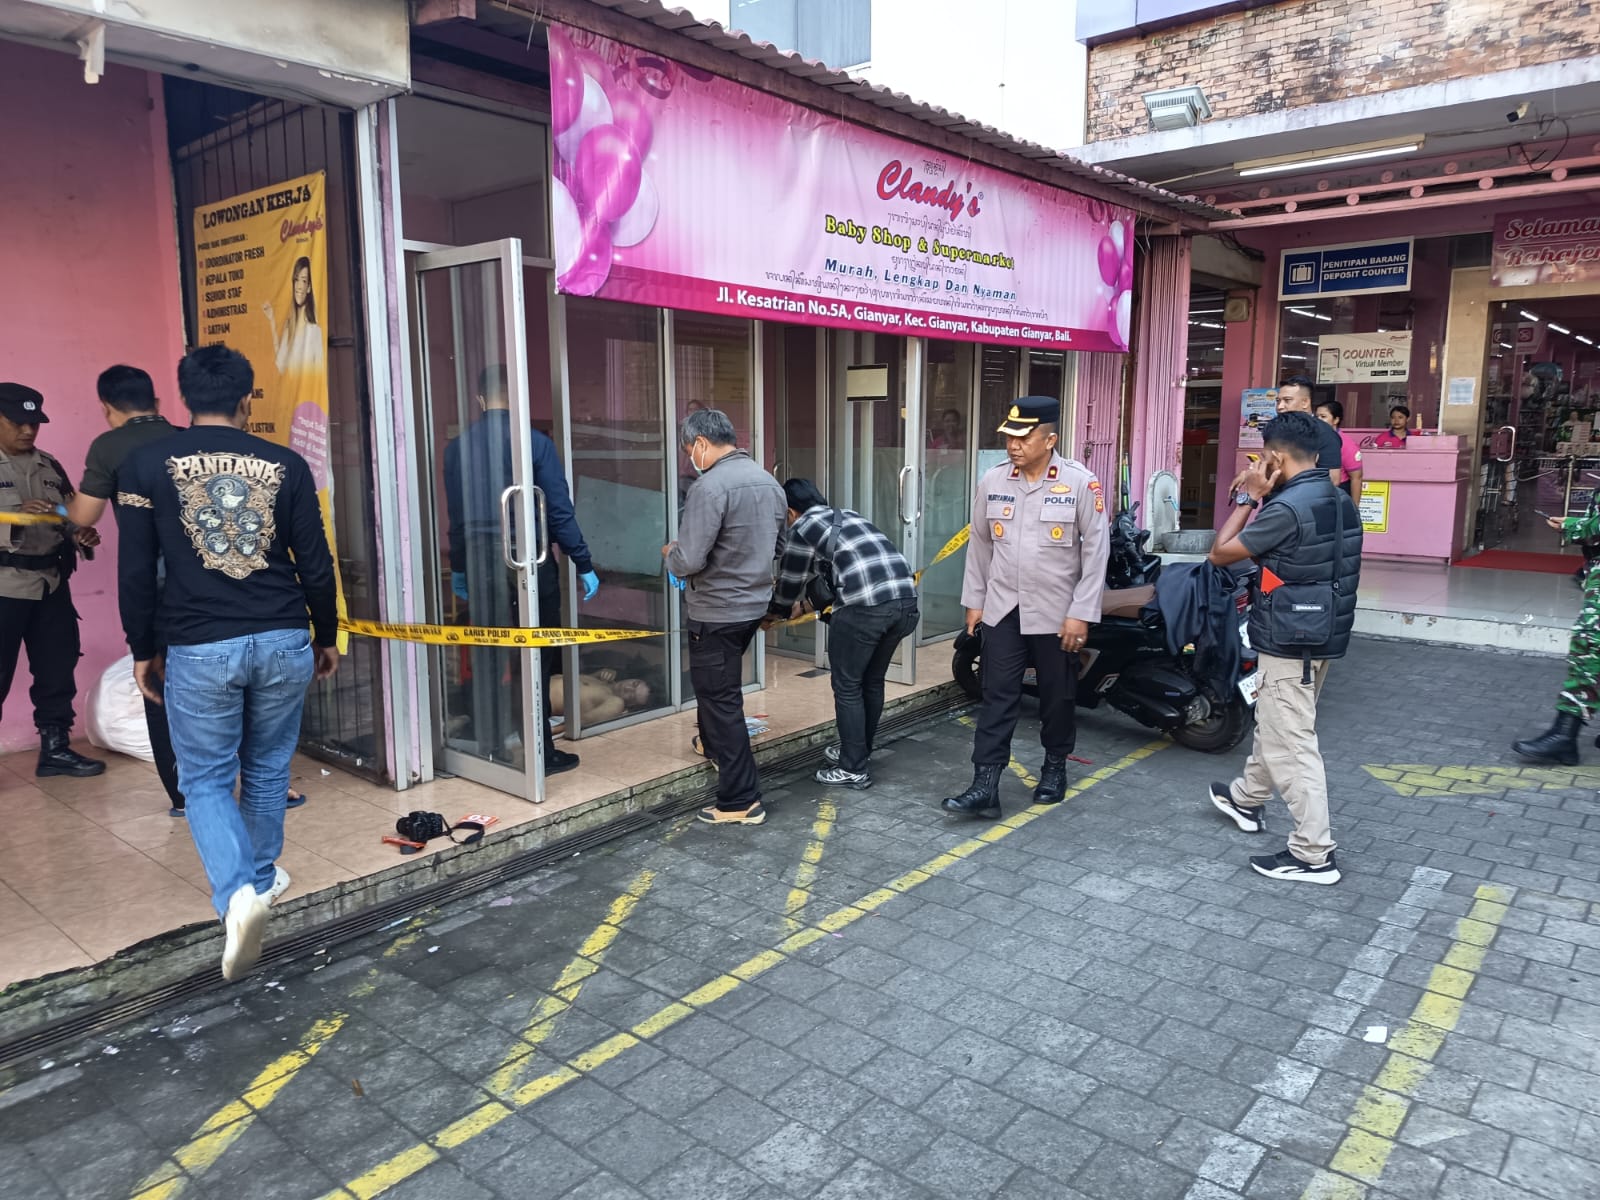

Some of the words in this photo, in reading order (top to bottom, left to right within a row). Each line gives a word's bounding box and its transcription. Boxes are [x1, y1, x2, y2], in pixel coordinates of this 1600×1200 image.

[877, 160, 981, 221] Clandy's
[203, 197, 265, 229] LOWONGAN
[266, 184, 312, 212] KERJA
[825, 215, 867, 243] Baby
[872, 226, 911, 252] Shop
[917, 237, 928, 253] &
[1504, 216, 1600, 240] Selama
[244, 246, 265, 260] FRESH
[1323, 258, 1368, 269] PENITIPAN
[1370, 254, 1406, 264] BARANG
[1504, 244, 1600, 268] Rahaje
[824, 258, 878, 280] Murah,
[884, 269, 939, 290] Lengkap
[945, 280, 968, 293] Dan
[973, 284, 1016, 300] Nyaman
[1323, 270, 1360, 280] DEPOSIT
[1362, 266, 1405, 277] COUNTER
[227, 287, 242, 299] STAF
[716, 287, 734, 303] Jl.
[737, 290, 805, 313] Kesatrian
[808, 300, 852, 320] No.5A,
[854, 307, 902, 327] Gianyar,
[904, 313, 926, 327] Kec.
[928, 316, 969, 334] Gianyar,
[971, 321, 1020, 338] Kabupaten
[1021, 327, 1054, 342] Gianyar,
[1055, 330, 1072, 342] Bali.
[1343, 348, 1394, 359] COUNTER
[1355, 360, 1375, 368] Virtual
[171, 455, 281, 486] PANDAWA
[1044, 497, 1075, 505] POLRI
[464, 628, 485, 636] GARIS
[487, 629, 510, 638] POLISI
